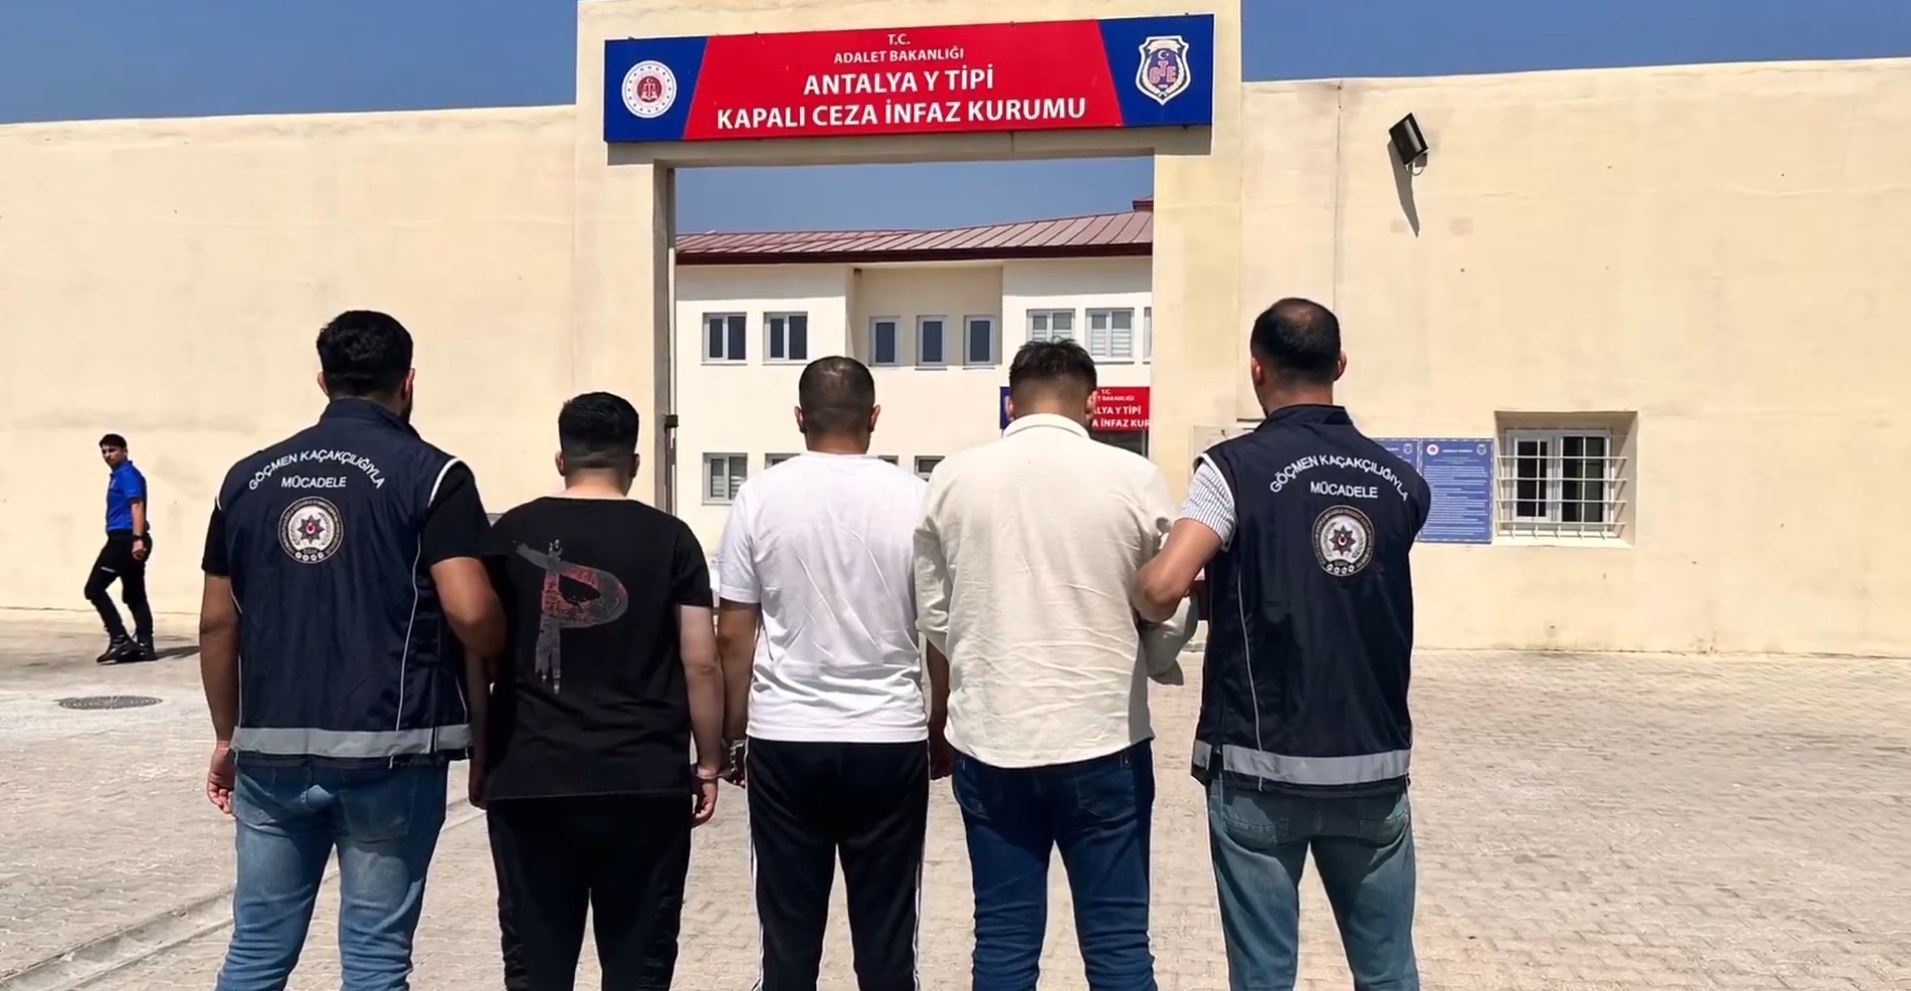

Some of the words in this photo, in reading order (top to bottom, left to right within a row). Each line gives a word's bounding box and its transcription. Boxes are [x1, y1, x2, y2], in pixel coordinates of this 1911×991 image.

[888, 33, 911, 45] T.C.
[834, 51, 887, 64] ADALET
[890, 45, 964, 62] BAKANLIĞI
[803, 72, 918, 96] ANTALYA
[923, 71, 939, 91] Y
[945, 64, 993, 91] TİPİ
[717, 106, 805, 130] KAPALI
[812, 104, 878, 126] CEZA
[885, 99, 961, 124] İNFAZ
[968, 97, 1086, 122] KURUMU
[1115, 406, 1121, 414] Y
[1123, 405, 1141, 415] TİPİ
[1101, 418, 1129, 428] İNFAZ
[249, 453, 297, 490] GÖÇMEN
[300, 449, 386, 489] KAÇAKÇILIĞIYLA
[1269, 455, 1319, 493] GÖÇMEN
[281, 475, 347, 488] MÜCADELE
[1310, 480, 1378, 498] MÜCADELE
